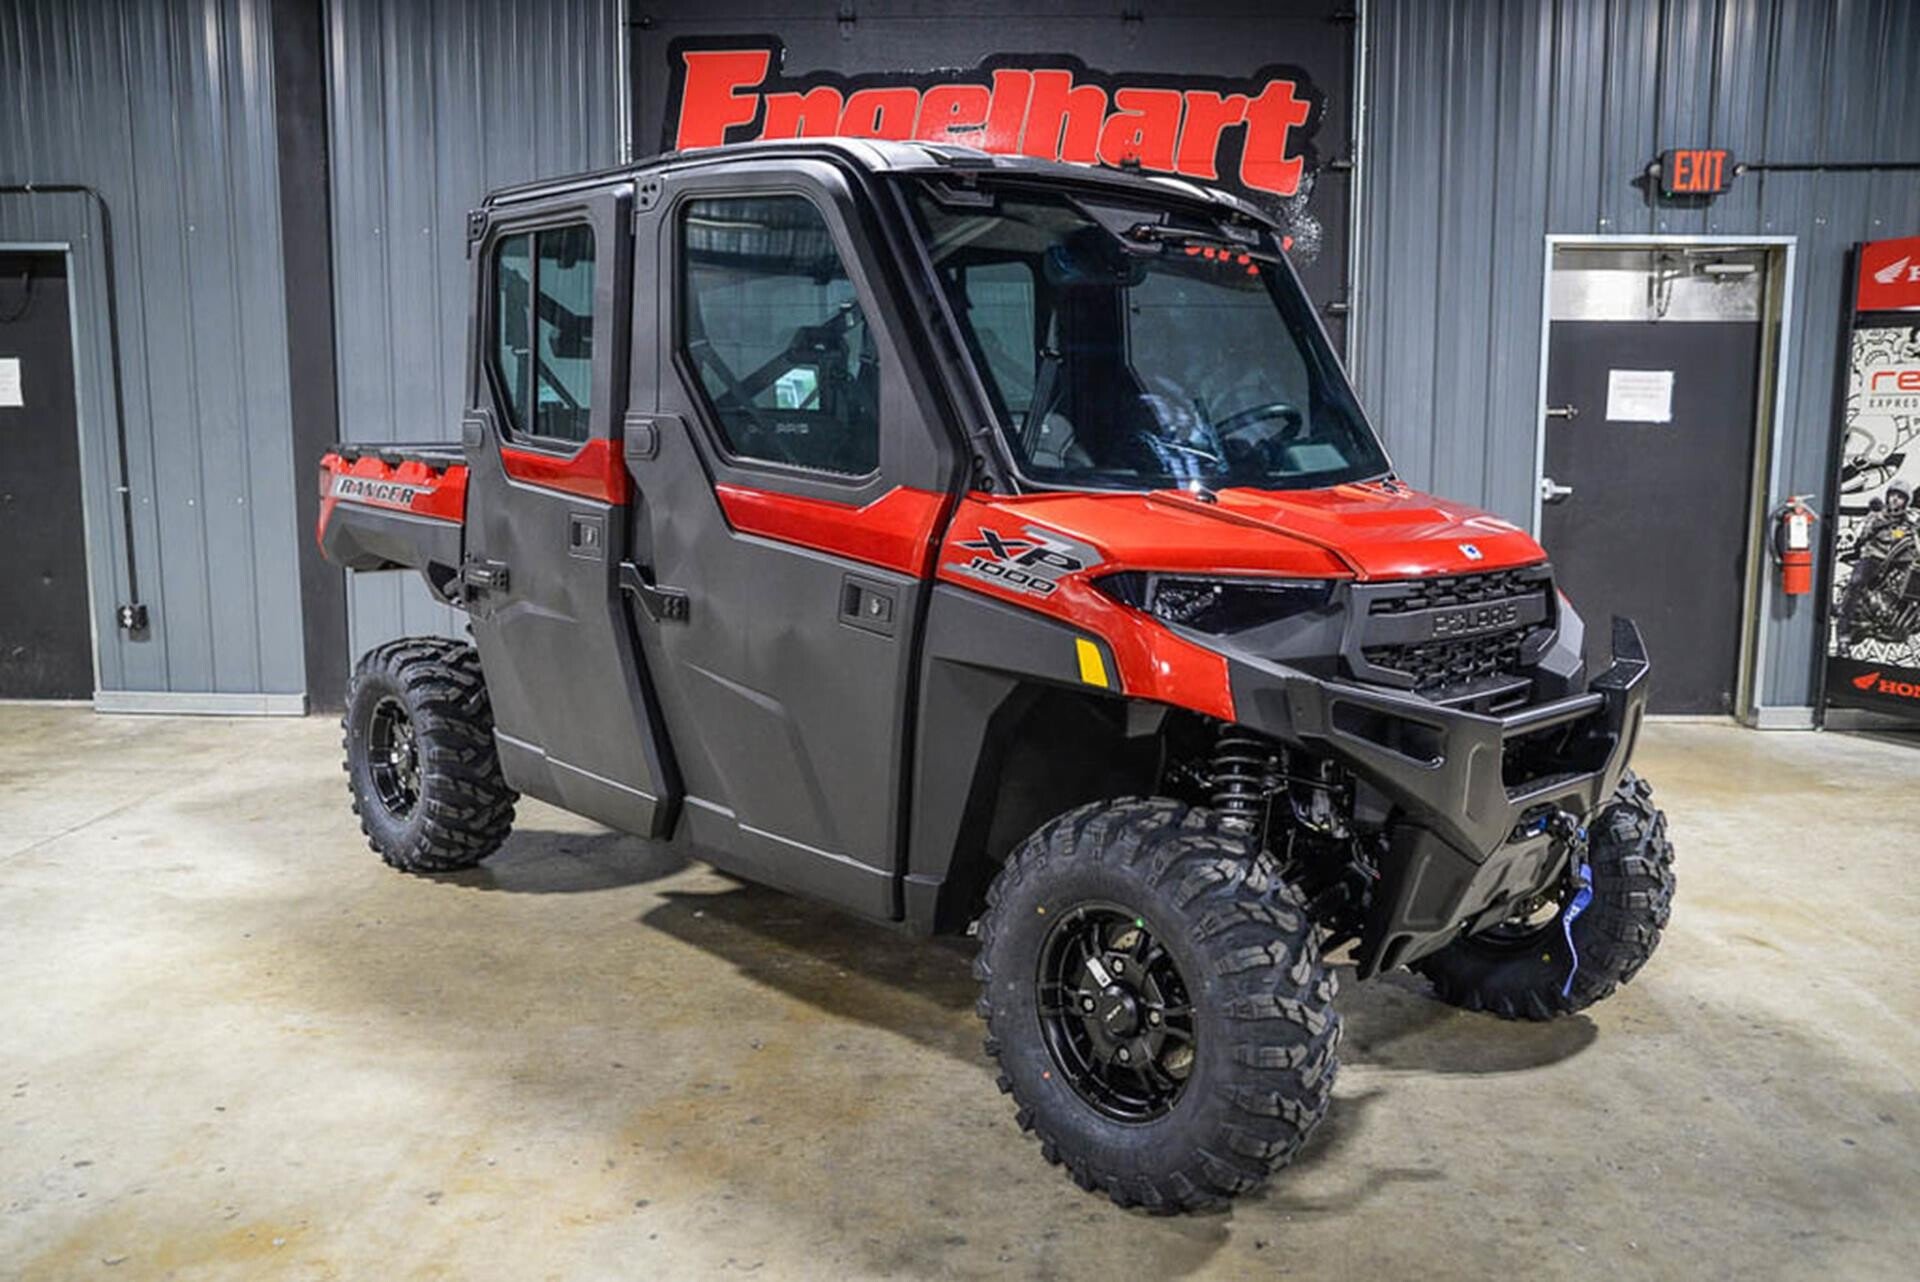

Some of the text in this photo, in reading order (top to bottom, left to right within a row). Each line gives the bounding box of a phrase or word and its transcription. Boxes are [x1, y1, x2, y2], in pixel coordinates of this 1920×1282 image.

[1672, 150, 1726, 192] EXIT
[339, 479, 415, 504] RANGER
[955, 527, 1085, 572] XP
[968, 556, 1058, 595] 1000
